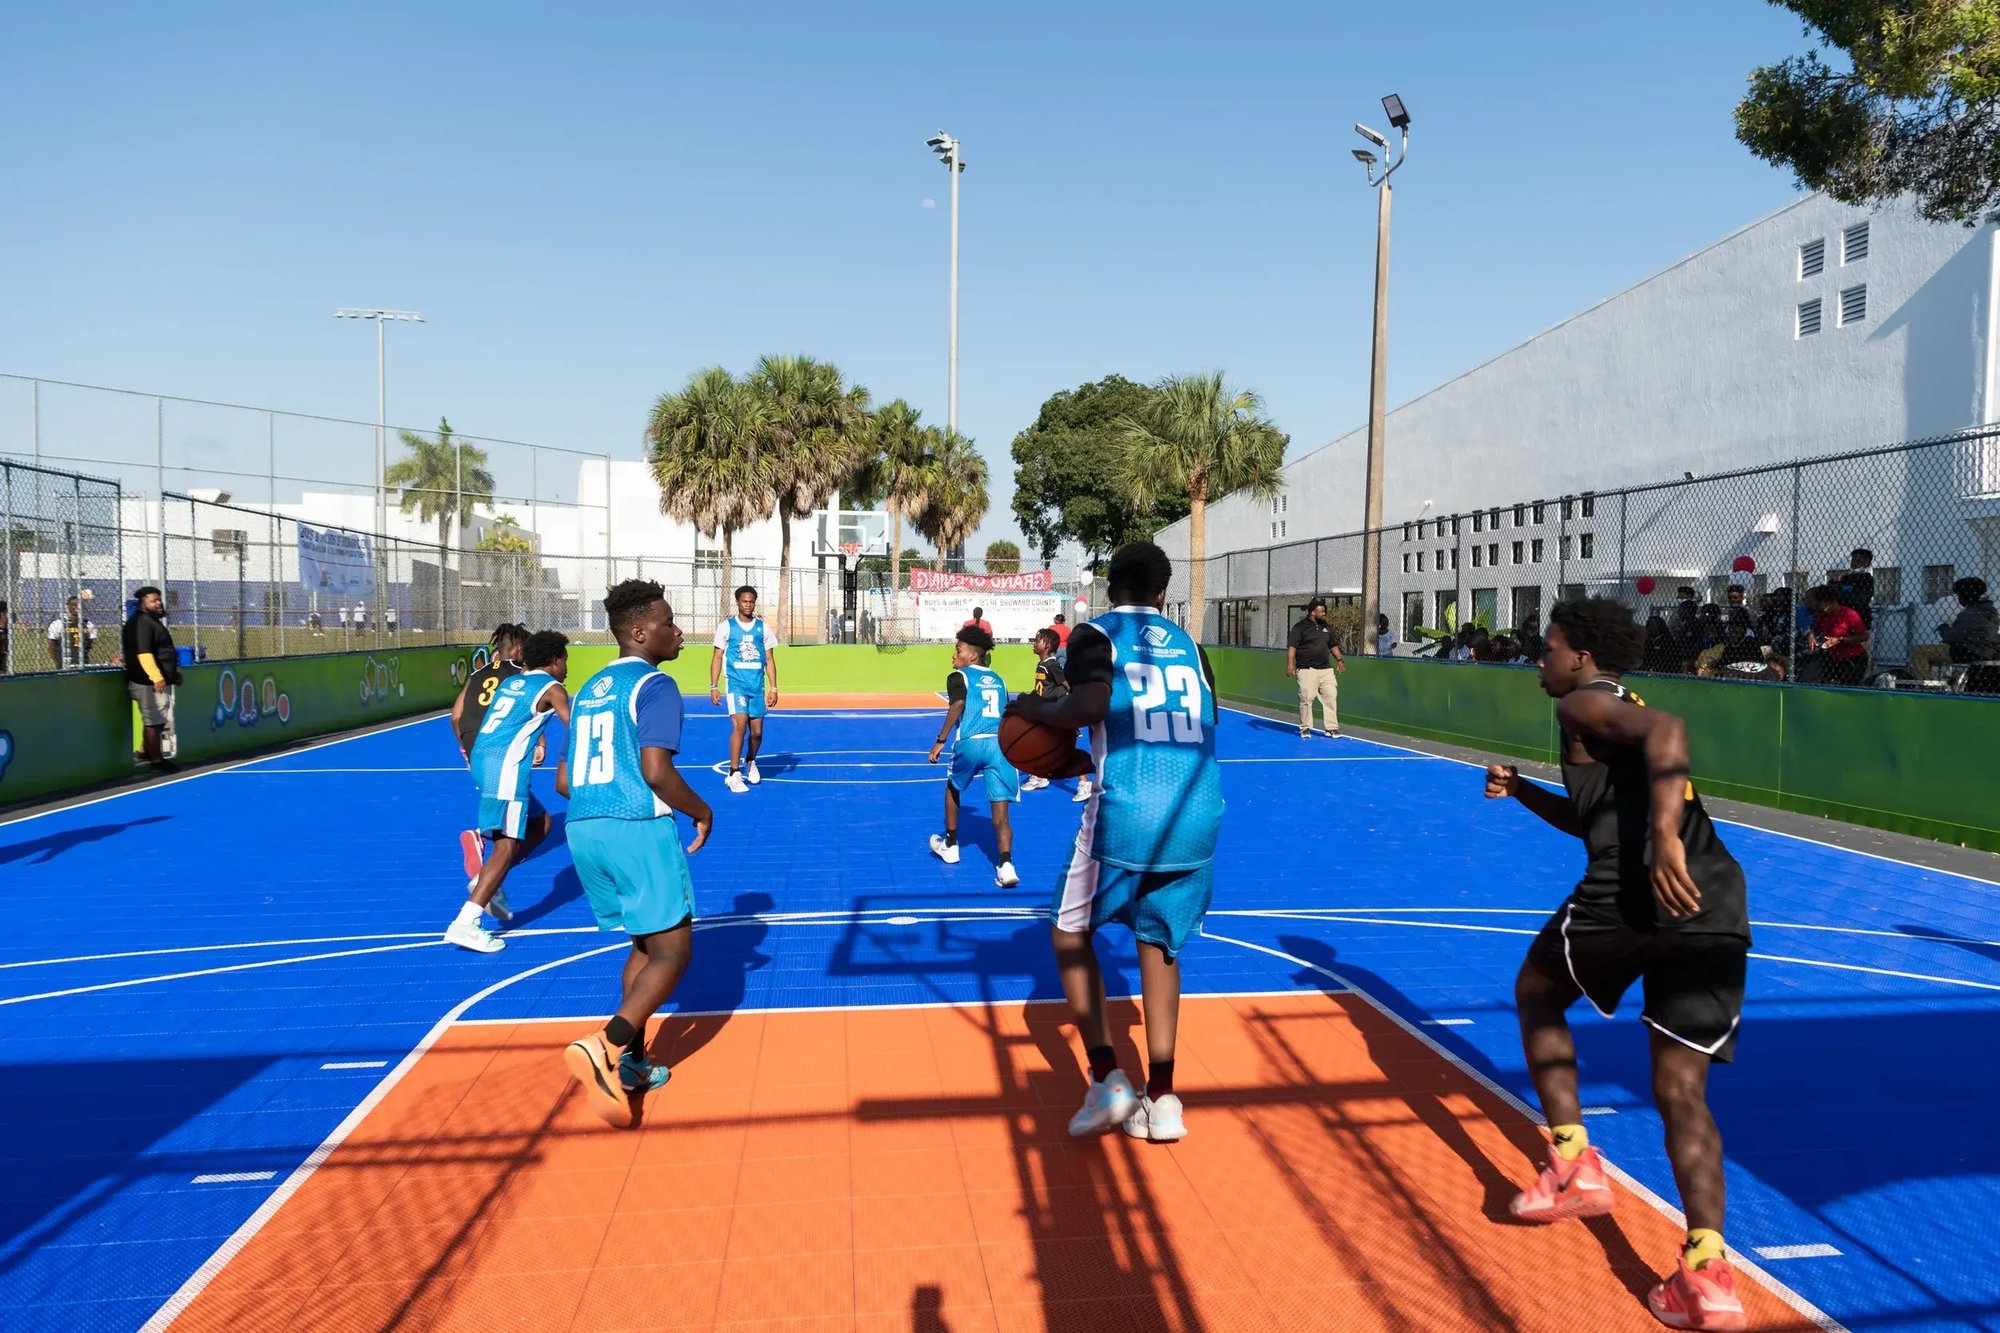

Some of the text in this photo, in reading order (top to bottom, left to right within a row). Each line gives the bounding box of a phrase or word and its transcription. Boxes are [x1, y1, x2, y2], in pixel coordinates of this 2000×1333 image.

[999, 598, 1031, 606] BROWARD
[1031, 598, 1056, 606] COUNTY
[478, 676, 499, 706] 3
[981, 689, 1001, 718] 3
[1124, 662, 1204, 744] 23
[480, 696, 516, 734] 2
[572, 710, 615, 788] 13
